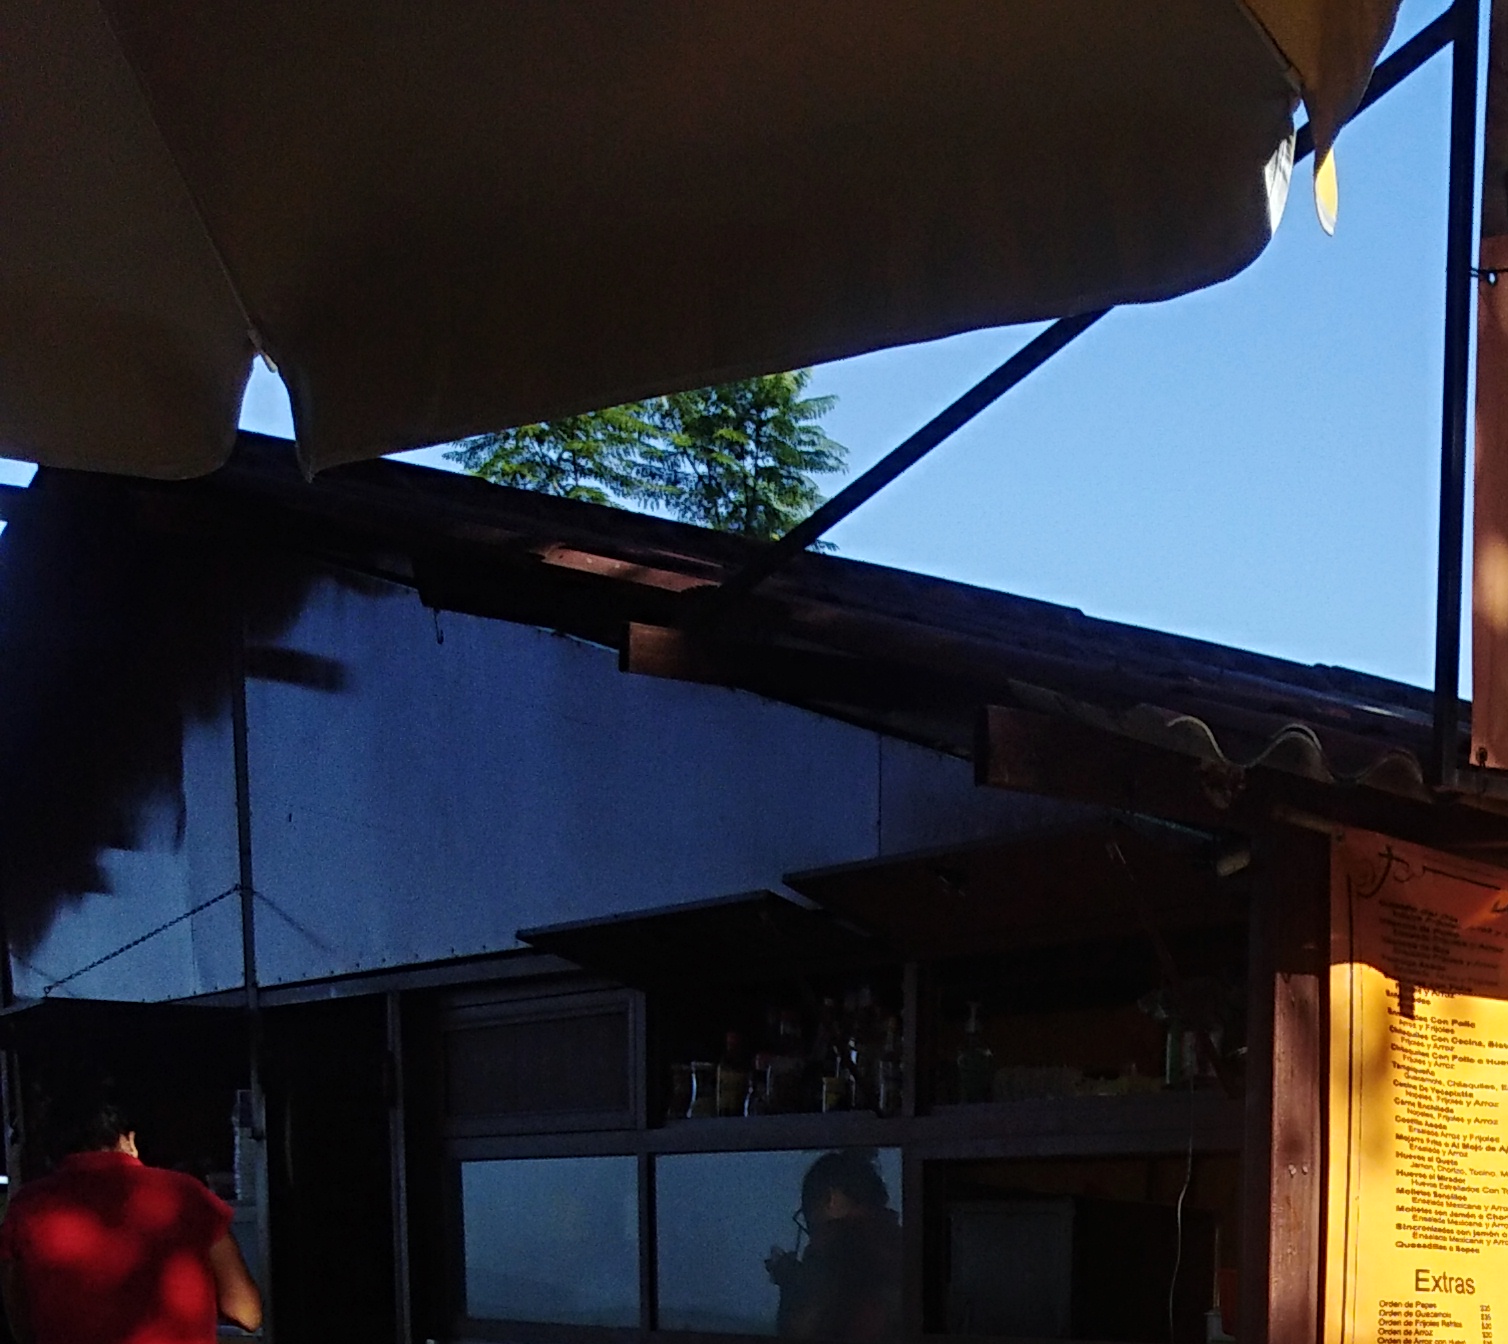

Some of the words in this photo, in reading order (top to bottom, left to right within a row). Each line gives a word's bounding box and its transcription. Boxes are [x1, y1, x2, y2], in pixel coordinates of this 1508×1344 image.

[1415, 1269, 1475, 1294] Extras
[1379, 1300, 1402, 1308] Orden
[1379, 1309, 1402, 1317] Orden
